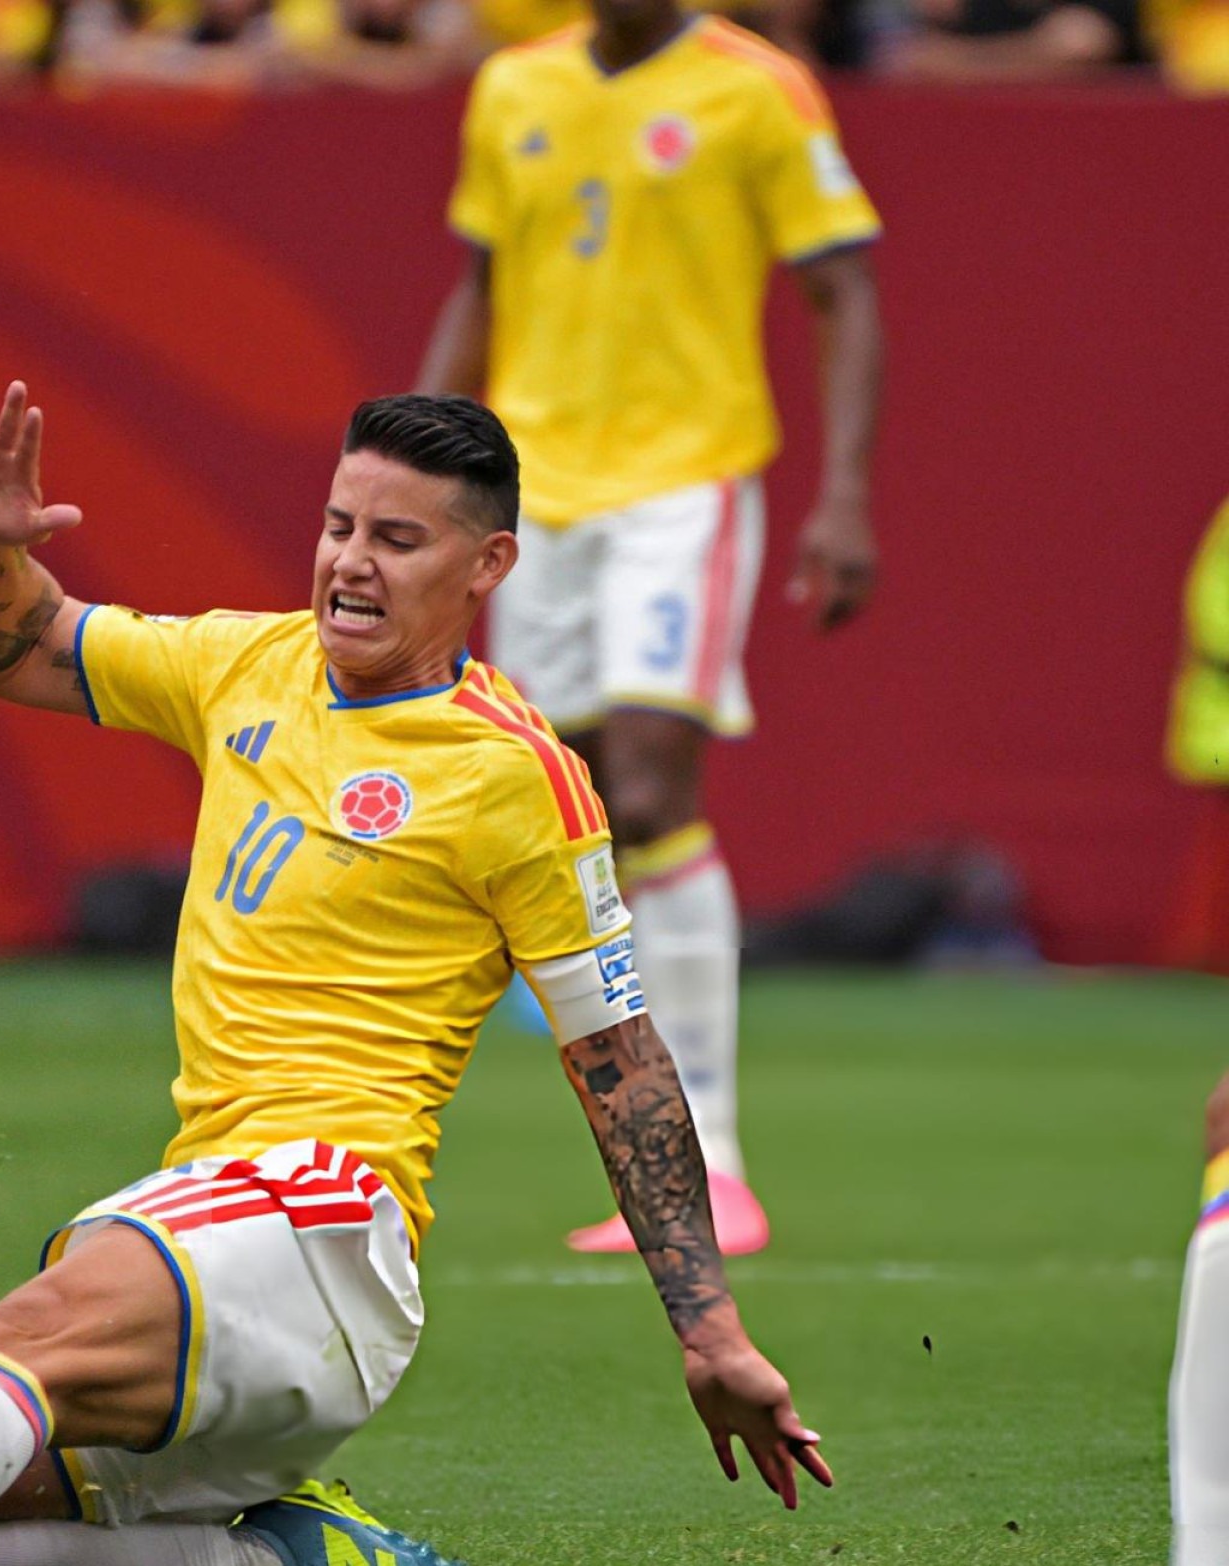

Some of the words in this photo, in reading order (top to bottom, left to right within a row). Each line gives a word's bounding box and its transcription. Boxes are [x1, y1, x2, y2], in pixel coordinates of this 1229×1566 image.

[572, 178, 610, 260] 3
[640, 590, 689, 670] 3
[214, 800, 305, 915] 10
